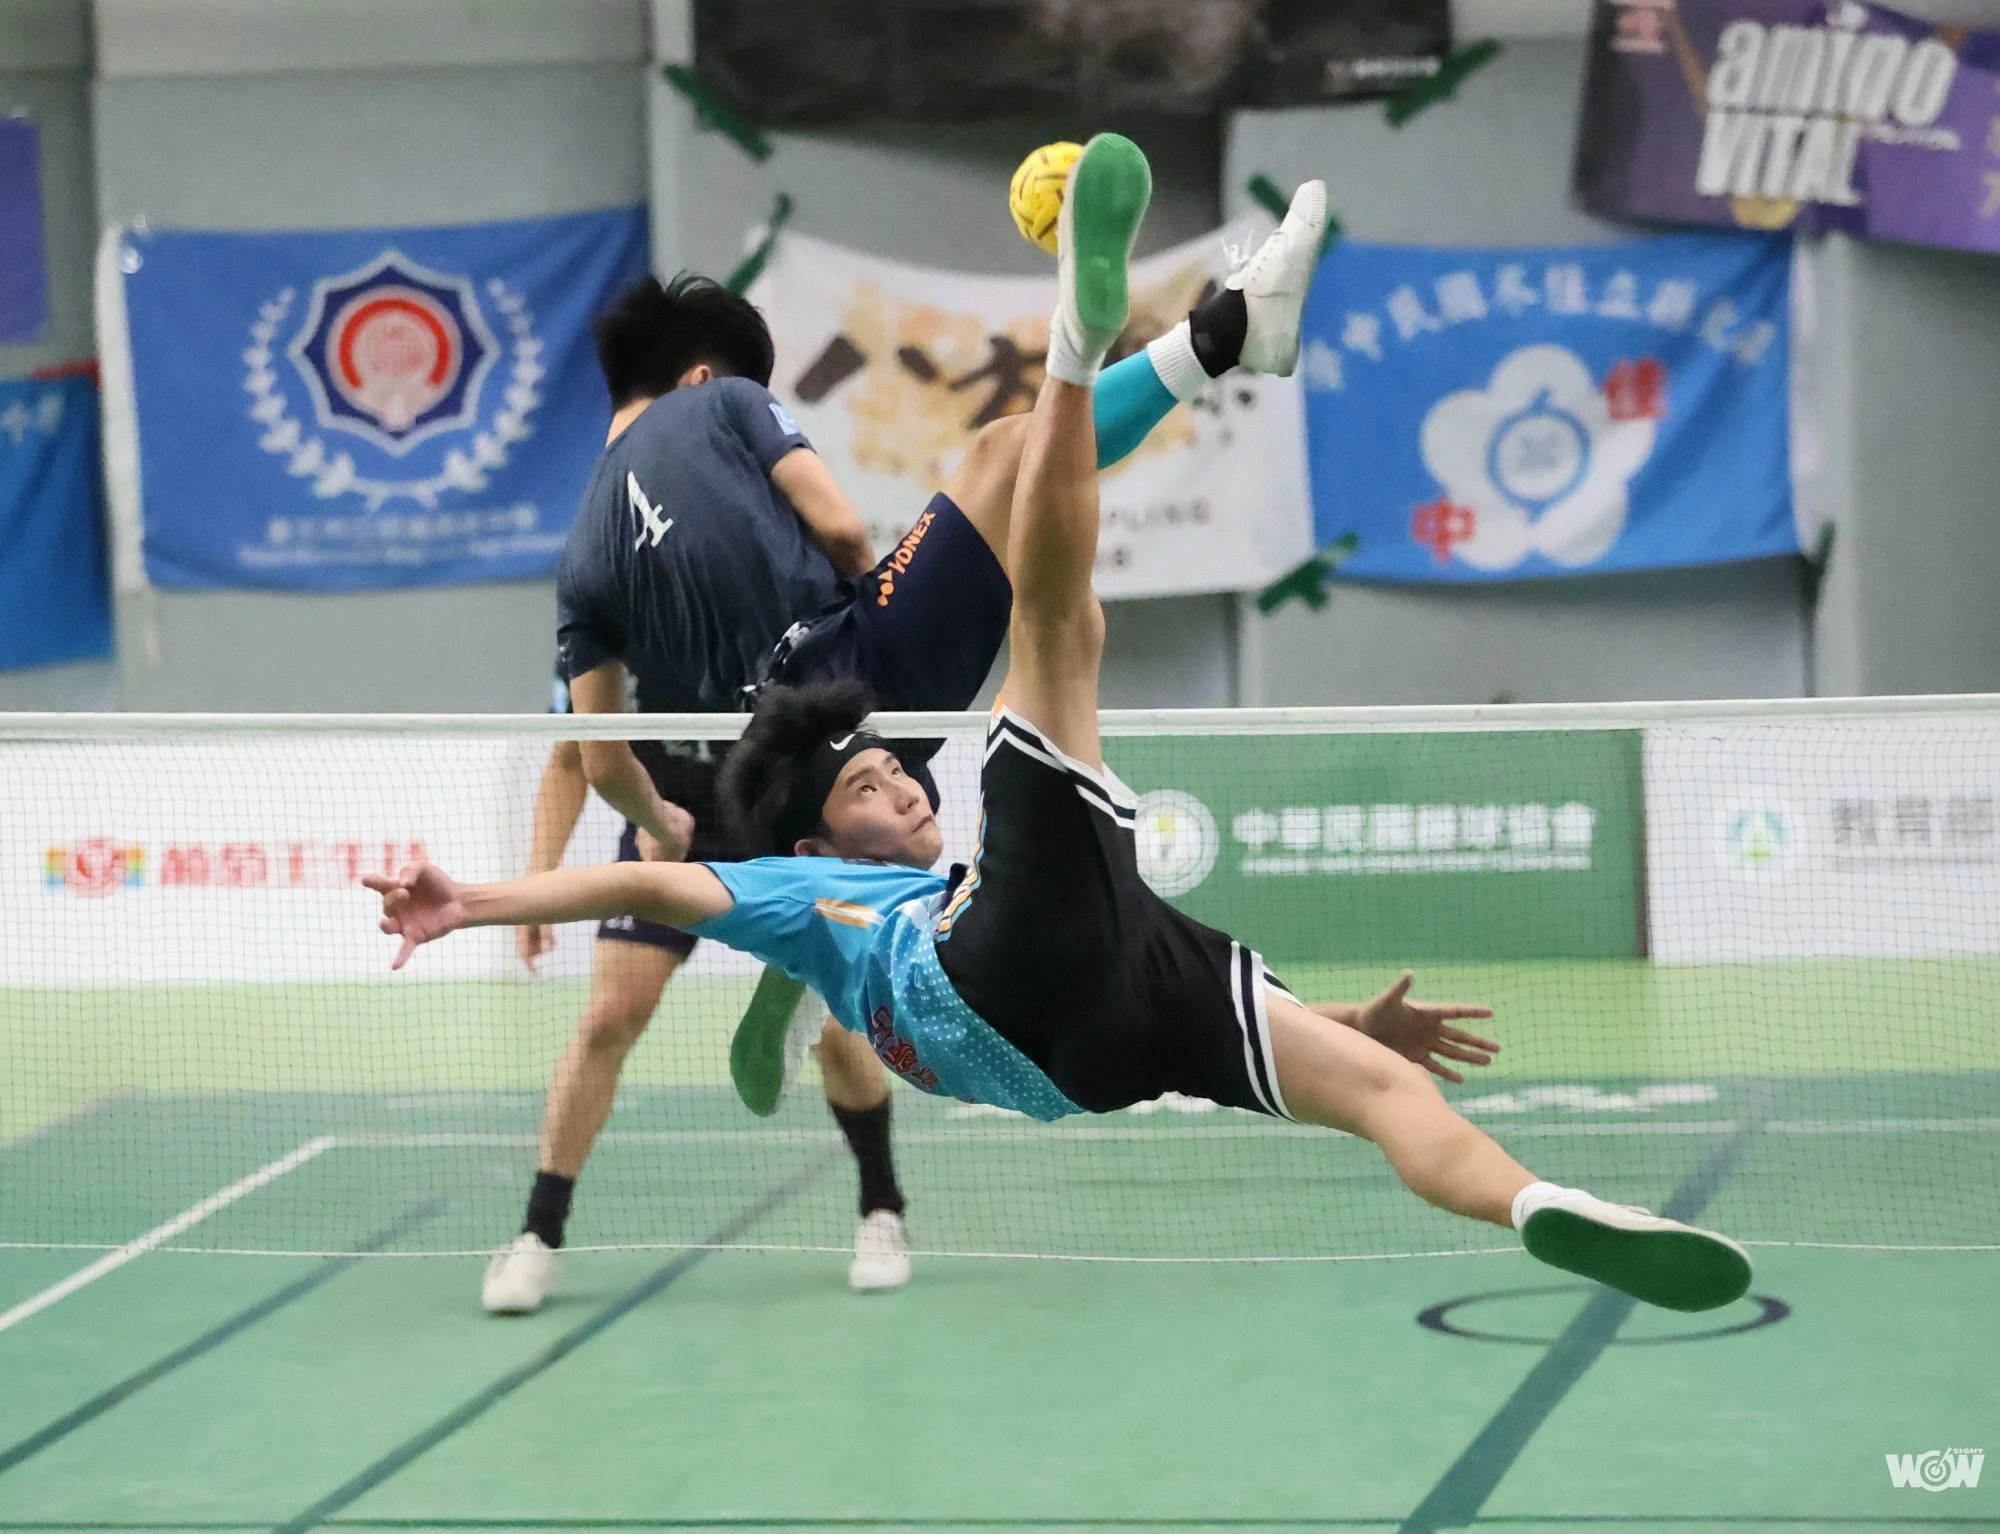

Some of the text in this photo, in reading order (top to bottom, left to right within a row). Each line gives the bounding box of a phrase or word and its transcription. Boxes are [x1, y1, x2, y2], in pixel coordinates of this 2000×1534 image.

[1706, 2, 1958, 126] amino
[1695, 108, 1862, 206] VITAL
[627, 471, 674, 552] 4
[887, 511, 937, 575] YONEX
